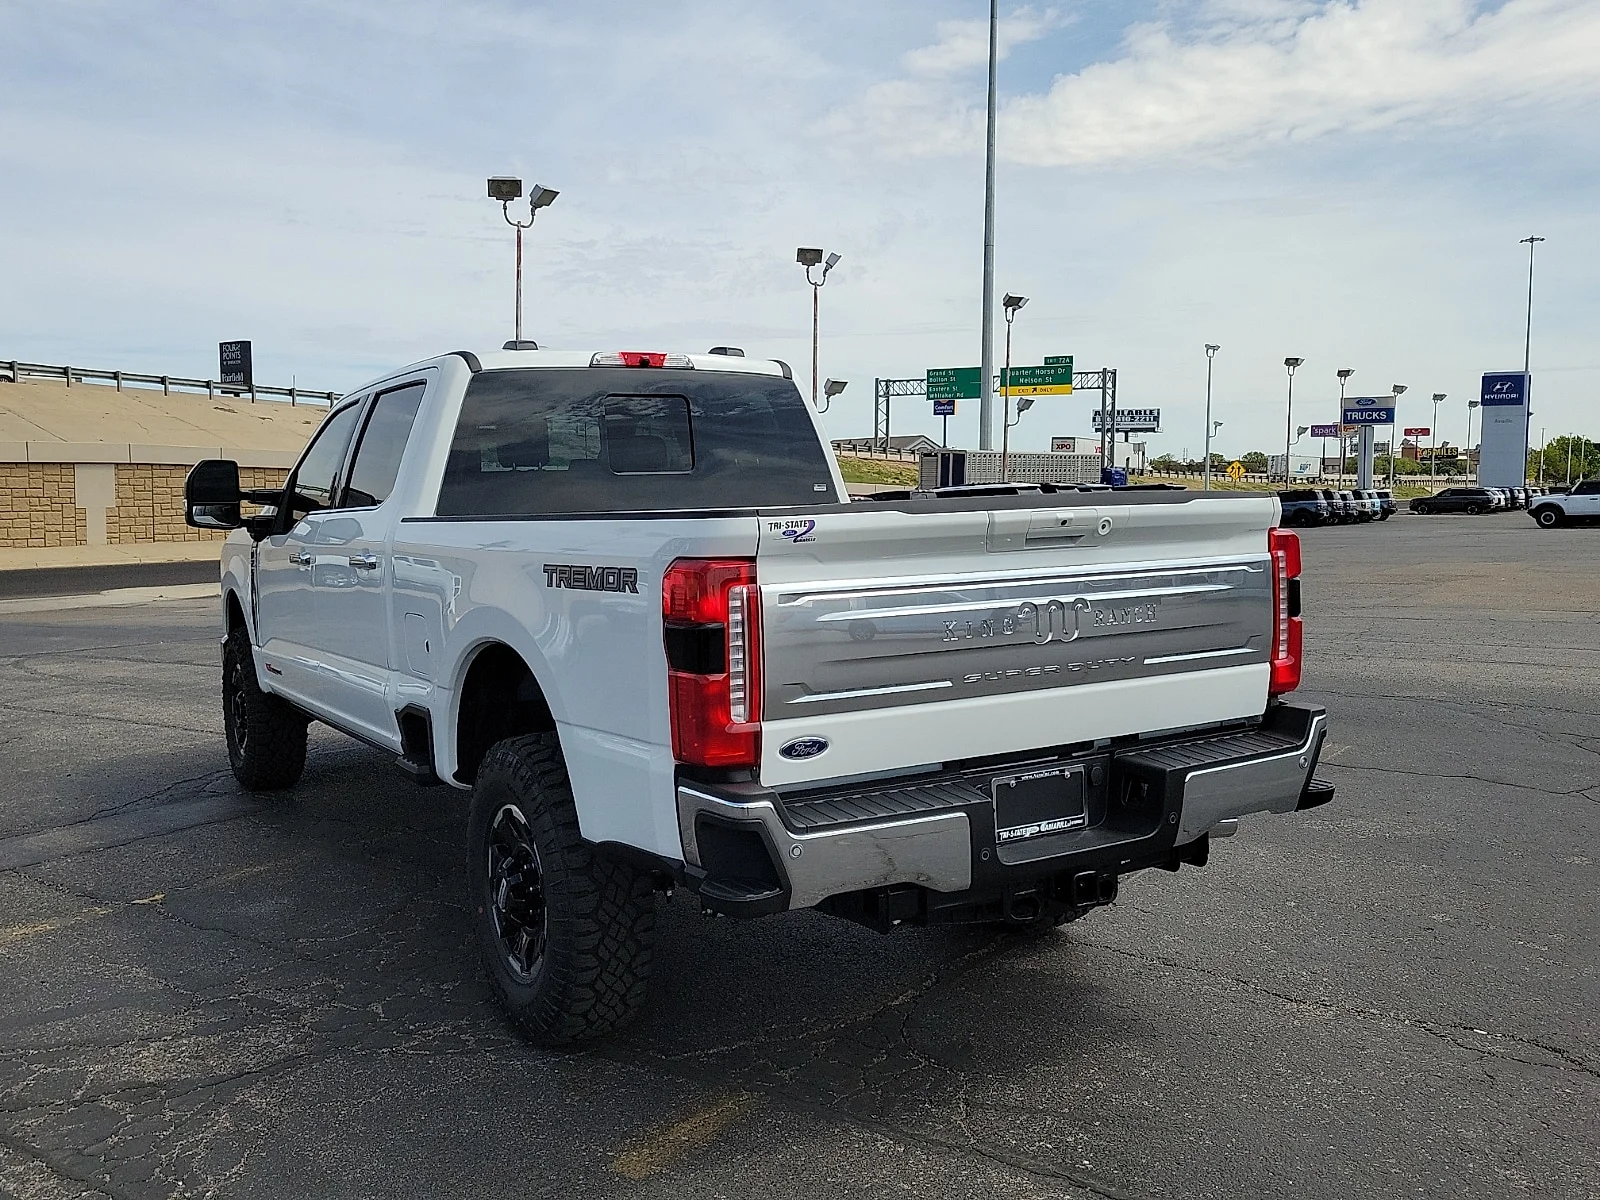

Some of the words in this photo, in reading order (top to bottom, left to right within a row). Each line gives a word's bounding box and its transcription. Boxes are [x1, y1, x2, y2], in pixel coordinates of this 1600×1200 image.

[222, 351, 241, 360] POINTS
[1005, 369, 1032, 377] uarter
[1035, 368, 1055, 376] Horse
[1057, 367, 1066, 375] Dr
[1093, 409, 1157, 418] AILABLE
[1345, 410, 1388, 421] TRUCKS
[1314, 426, 1338, 436] spark
[768, 520, 807, 532] TRI-STATE
[543, 564, 639, 594] TREMOR
[942, 617, 1014, 642] KING
[1093, 603, 1158, 627] RANCH
[963, 664, 1061, 684] SUPER
[1067, 656, 1136, 672] DUTY
[791, 741, 820, 756] Ford
